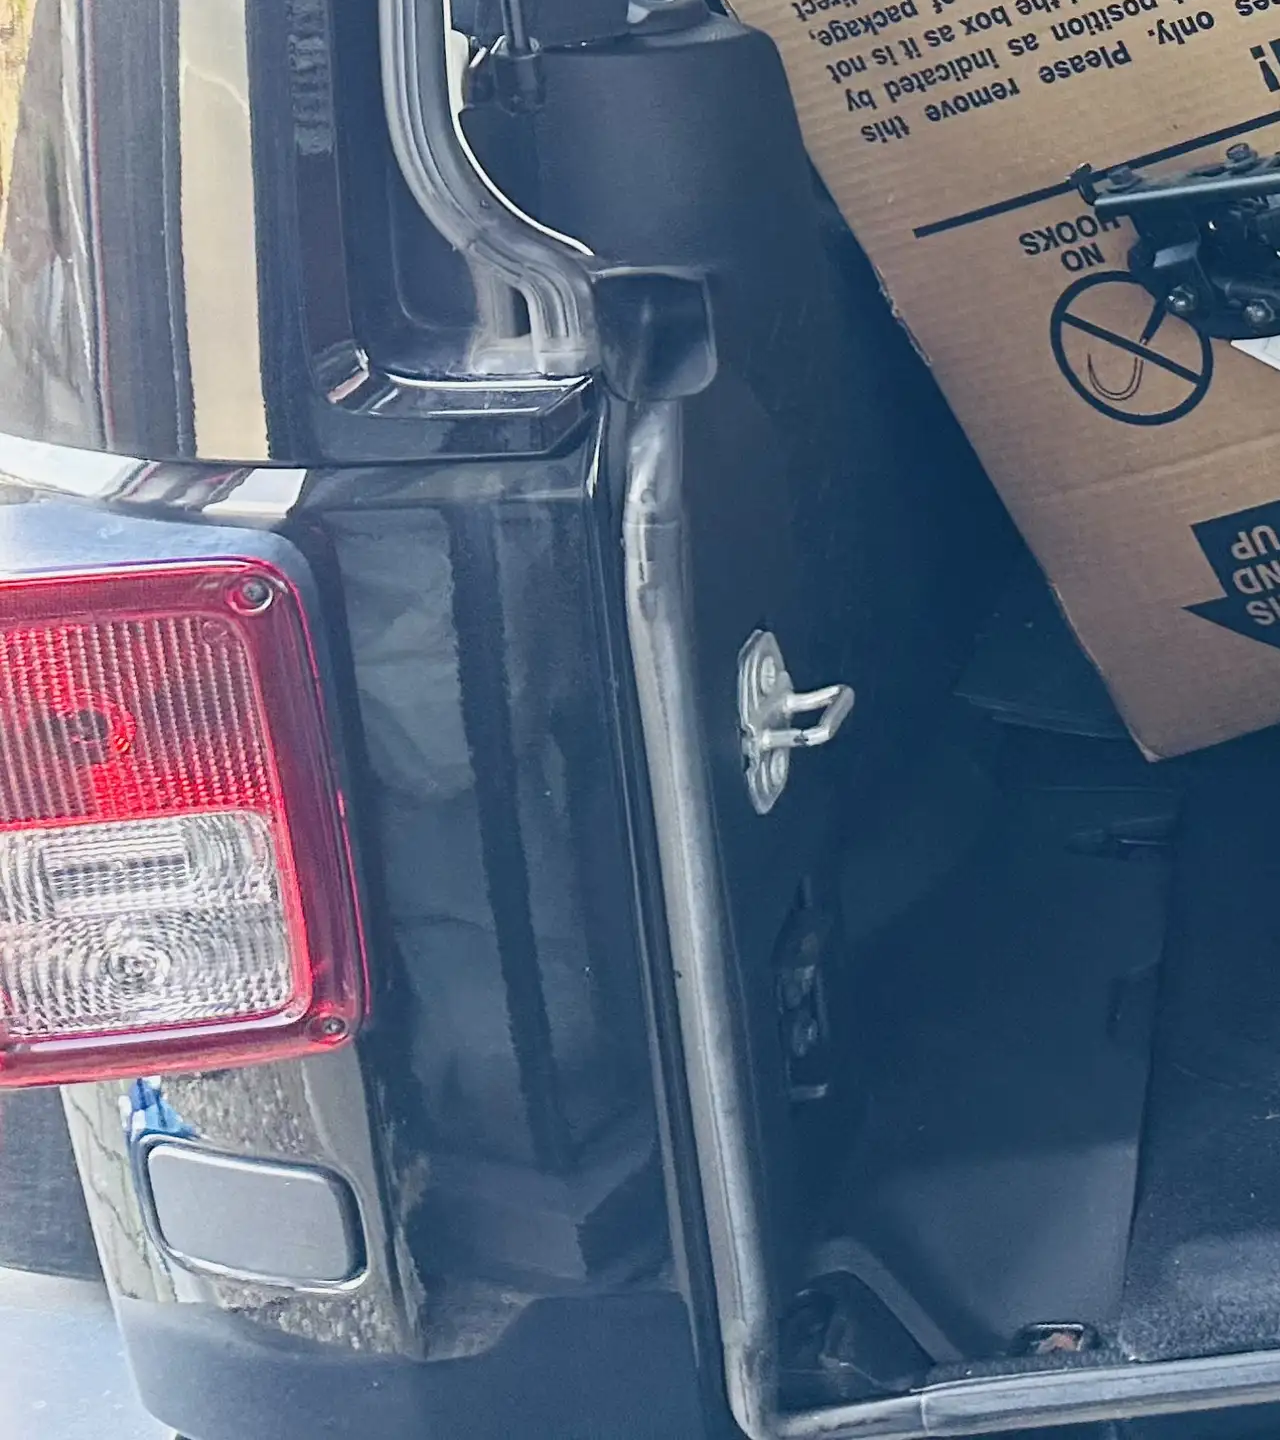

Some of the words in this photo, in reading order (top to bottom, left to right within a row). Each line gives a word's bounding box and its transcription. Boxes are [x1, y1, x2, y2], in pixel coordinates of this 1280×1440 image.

[921, 23, 956, 48] as
[956, 3, 1014, 37] box
[1145, 9, 1216, 46] only.
[869, 43, 900, 67] is
[896, 35, 923, 61] it
[1005, 31, 1041, 58] as
[824, 53, 868, 85] not
[881, 46, 1001, 104] indicated
[1036, 38, 1133, 85] Please
[843, 86, 879, 113] by
[922, 75, 1021, 123] remove
[859, 113, 911, 144] this
[1060, 241, 1105, 272] NO
